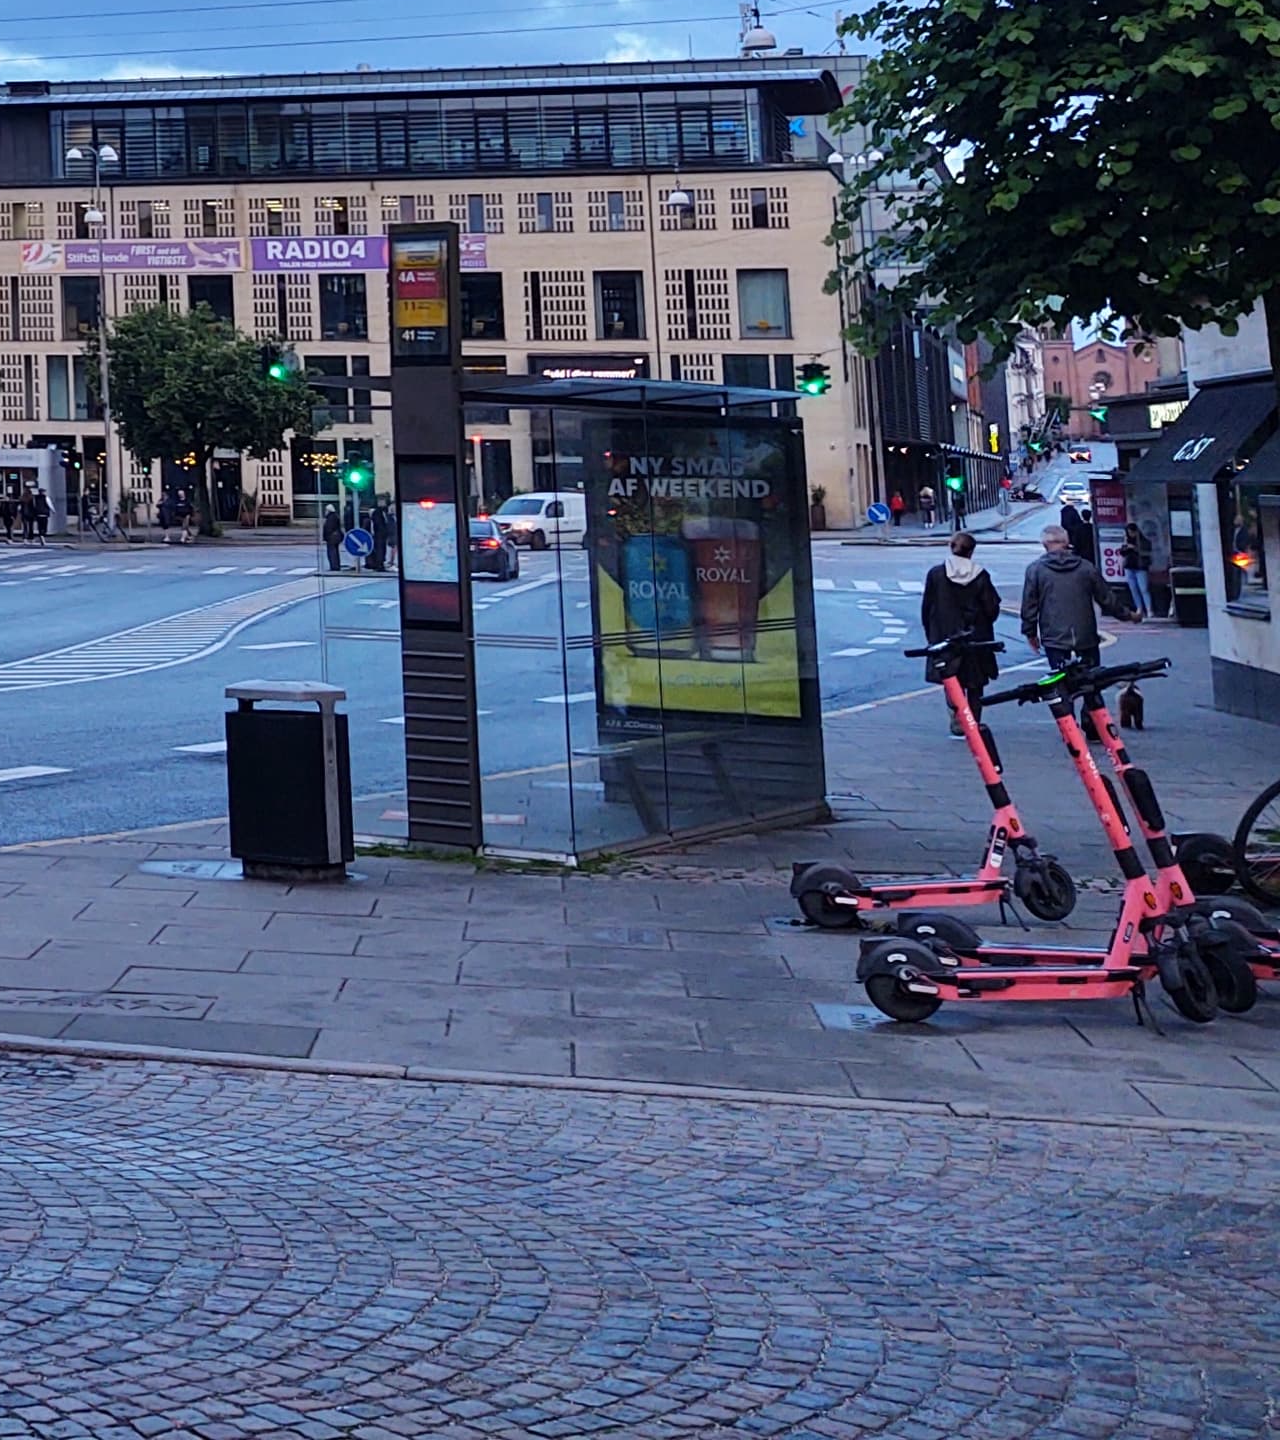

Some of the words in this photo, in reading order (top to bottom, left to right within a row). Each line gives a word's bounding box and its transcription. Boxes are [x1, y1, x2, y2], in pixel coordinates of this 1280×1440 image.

[266, 240, 366, 260] RADIO4
[399, 271, 416, 282] 4A
[402, 330, 415, 341] 41
[630, 457, 664, 476] NY
[671, 457, 745, 477] SMAG
[608, 478, 638, 497] AF
[645, 478, 770, 499] WEEKEND
[697, 567, 752, 584] ROYAL
[629, 579, 689, 599] ROYAL
